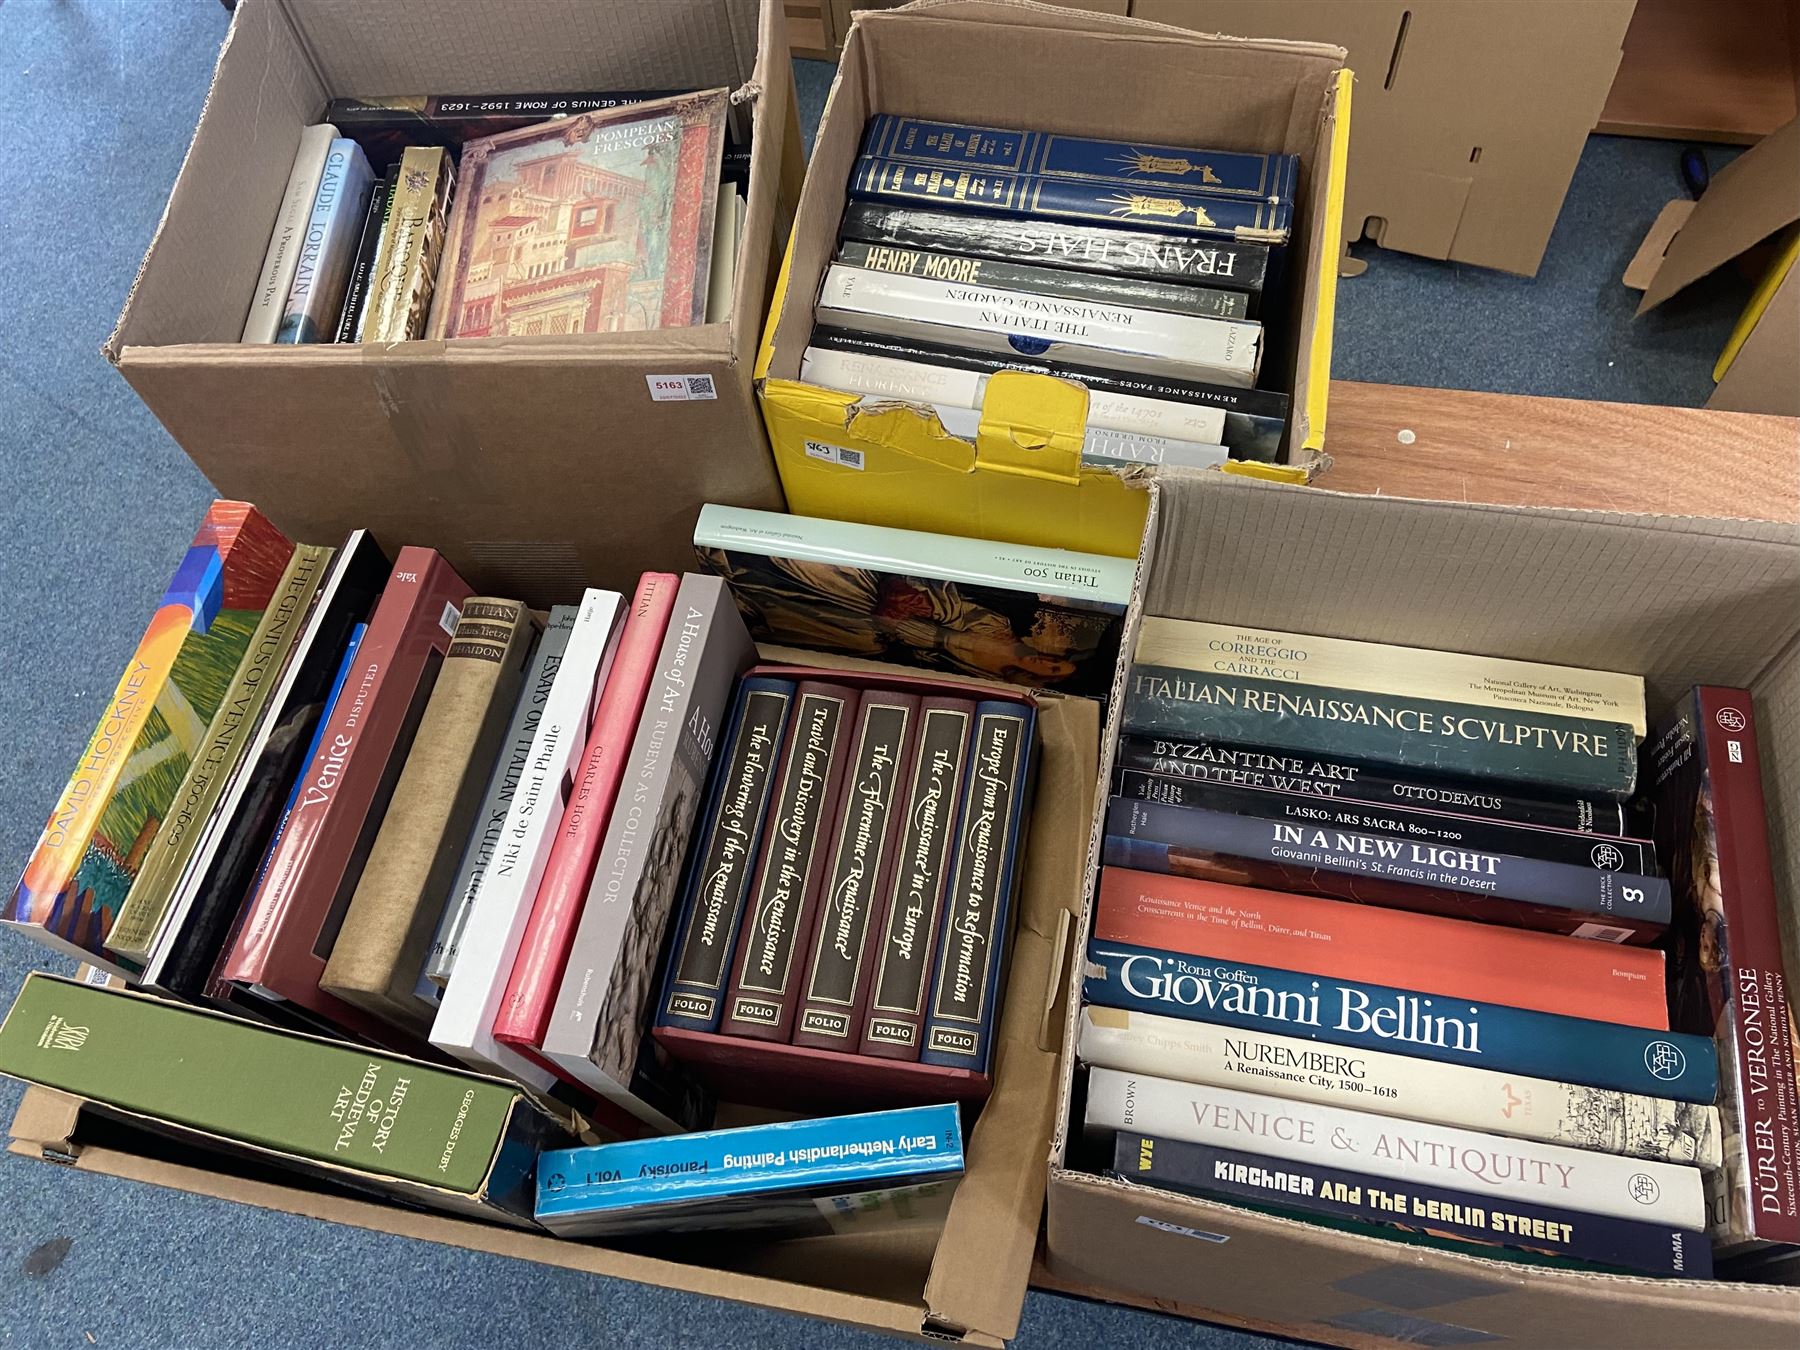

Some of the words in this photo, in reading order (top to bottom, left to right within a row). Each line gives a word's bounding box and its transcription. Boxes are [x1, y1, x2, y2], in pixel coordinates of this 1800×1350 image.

[515, 101, 546, 110] ROME
[552, 101, 566, 109] OF
[571, 99, 615, 109] GENIUS
[593, 133, 673, 155] FRESCOES
[595, 120, 675, 143] POMPEIAN
[316, 152, 344, 212] CLAUDE
[285, 226, 293, 234] A
[1018, 229, 1111, 260] HALS
[294, 223, 326, 296] LORRAIN
[864, 247, 920, 274] HENRY
[922, 255, 982, 283] MOORE
[1124, 242, 1237, 277] FRANS
[843, 277, 856, 298] YALE
[945, 288, 1013, 304] GARDEN
[979, 311, 1049, 333] ITALIAN
[1019, 298, 1133, 325] RENAISSANCE
[1055, 321, 1088, 337] THE
[1225, 327, 1238, 361] LAZZARO
[1119, 381, 1153, 391] FACES
[1158, 386, 1238, 404] RENAISSANCE
[806, 442, 830, 454] 5163
[1094, 430, 1135, 442] URBINO
[396, 571, 417, 582] Yale
[1024, 568, 1049, 578] 500
[1054, 571, 1099, 587] Titian
[467, 605, 517, 619] TITIAN
[637, 581, 656, 618] TITIAN
[687, 606, 703, 618] A
[253, 595, 298, 666] GENIUS
[673, 622, 701, 668] House
[1236, 634, 1250, 642] THE
[1251, 636, 1270, 644] AGE
[1209, 639, 1308, 661] CORREGGIO
[1238, 656, 1257, 664] AND
[1214, 660, 1300, 681] CARRACCI
[659, 687, 680, 713] Art
[1483, 677, 1512, 686] National
[1513, 681, 1537, 690] Gallery
[1563, 687, 1602, 697] Washington
[1483, 684, 1526, 696] Metropolitan
[1528, 690, 1557, 699] Museum
[1568, 695, 1581, 703] Art,
[1602, 699, 1619, 707] York
[1133, 675, 1237, 708] ITALIAN
[1242, 688, 1433, 733] RENAISSANCE
[1493, 693, 1527, 703] Pinacoteca
[1529, 697, 1564, 708] Nazionale,
[1566, 703, 1594, 712] Bologna
[206, 697, 251, 772] VENICE
[298, 733, 352, 812] Venice
[345, 663, 378, 728] DISPUTED
[750, 724, 771, 750] The
[808, 708, 828, 756] Travel
[46, 779, 91, 849] DAVID
[89, 663, 151, 773] HOCKNEY
[640, 719, 669, 780] RUBENS
[871, 744, 892, 771] The
[932, 750, 953, 776] The
[981, 727, 1007, 775] Europe
[1153, 740, 1303, 773] BYZANTINE
[1307, 762, 1359, 781] ART
[1615, 724, 1627, 774] PHAIDON
[577, 744, 604, 802] CHARLES
[800, 752, 822, 781] and
[725, 752, 764, 819] Flowering
[1268, 774, 1341, 796] WEST
[1392, 783, 1438, 801] OTTO
[1438, 790, 1502, 810] DEMUS
[496, 842, 522, 878] Niki
[518, 773, 545, 817] Saint
[534, 723, 562, 772] Phalle
[780, 777, 814, 847] Discovery
[858, 772, 884, 857] Florentine
[565, 803, 585, 839] HOPE
[1285, 805, 1332, 821] LASKO:
[1334, 811, 1360, 825] ARS
[1362, 816, 1405, 832] SACRA
[603, 806, 643, 905] COLLECTOR
[722, 837, 745, 860] the
[783, 847, 795, 863] in
[968, 809, 996, 895] Renaissance
[1272, 823, 1308, 845] IN
[1309, 830, 1330, 849] A
[1336, 833, 1403, 860] NEW
[1410, 845, 1501, 875] LIGHT
[779, 863, 801, 887] the
[1271, 846, 1321, 863] Giovanni
[1324, 854, 1367, 870] Bellini's
[1370, 861, 1384, 873] St.
[1387, 864, 1424, 879] Francis
[1440, 871, 1458, 884] the
[1460, 875, 1497, 891] Desert
[701, 861, 734, 946] Renaissance
[1139, 895, 1181, 908] Renaissance
[1184, 902, 1206, 912] Venice
[1208, 905, 1223, 914] and
[1225, 907, 1236, 916] the
[1239, 910, 1261, 920] North
[760, 889, 790, 977] Renaissance
[892, 890, 924, 960] Europe
[1138, 904, 1184, 918] Crosscurrents
[1197, 913, 1207, 922] the
[1210, 915, 1229, 925] Time
[1293, 929, 1307, 937] and
[1309, 930, 1332, 941] Titian
[954, 910, 985, 1003] Reformation
[1177, 960, 1211, 977] Rona
[1213, 967, 1259, 985] Goffen
[1764, 970, 1775, 1005] Gallery
[674, 999, 707, 1012] FOLIO
[739, 1005, 773, 1017] FOLIO
[1120, 955, 1322, 1027] Giovanni
[1333, 986, 1482, 1054] Bellini
[808, 1016, 842, 1029] FOLIO
[876, 1025, 910, 1038] FOLIO
[1738, 968, 1768, 1096] VERONESE
[1768, 1005, 1779, 1046] National
[937, 1034, 972, 1047] FOLIO
[1224, 1038, 1366, 1079] NUREMBERG
[1224, 1061, 1233, 1071] A
[1236, 1062, 1306, 1082] Renaissance
[1309, 1074, 1336, 1090] City,
[330, 1085, 353, 1122] ART
[334, 1062, 381, 1151] MEDIEVAL
[365, 1099, 383, 1124] OF
[371, 1077, 410, 1154] HISTORY
[449, 1089, 475, 1141] GEORGES
[1123, 1080, 1136, 1126] BROWN
[1777, 1080, 1787, 1122] Painting
[438, 1141, 456, 1172] DUBY
[789, 1140, 894, 1163] Netherlandish
[899, 1135, 937, 1151] Early
[1190, 1101, 1315, 1145] VENICE
[1372, 1134, 1575, 1189] ANTIQUITY
[638, 1159, 709, 1178] Panofsky
[722, 1151, 785, 1169] Painting
[1753, 1116, 1781, 1215] DÜRER
[1780, 1123, 1797, 1218] Sixteenth-Century
[1491, 1212, 1573, 1244] STREET
[1672, 1232, 1684, 1272] MoMA
